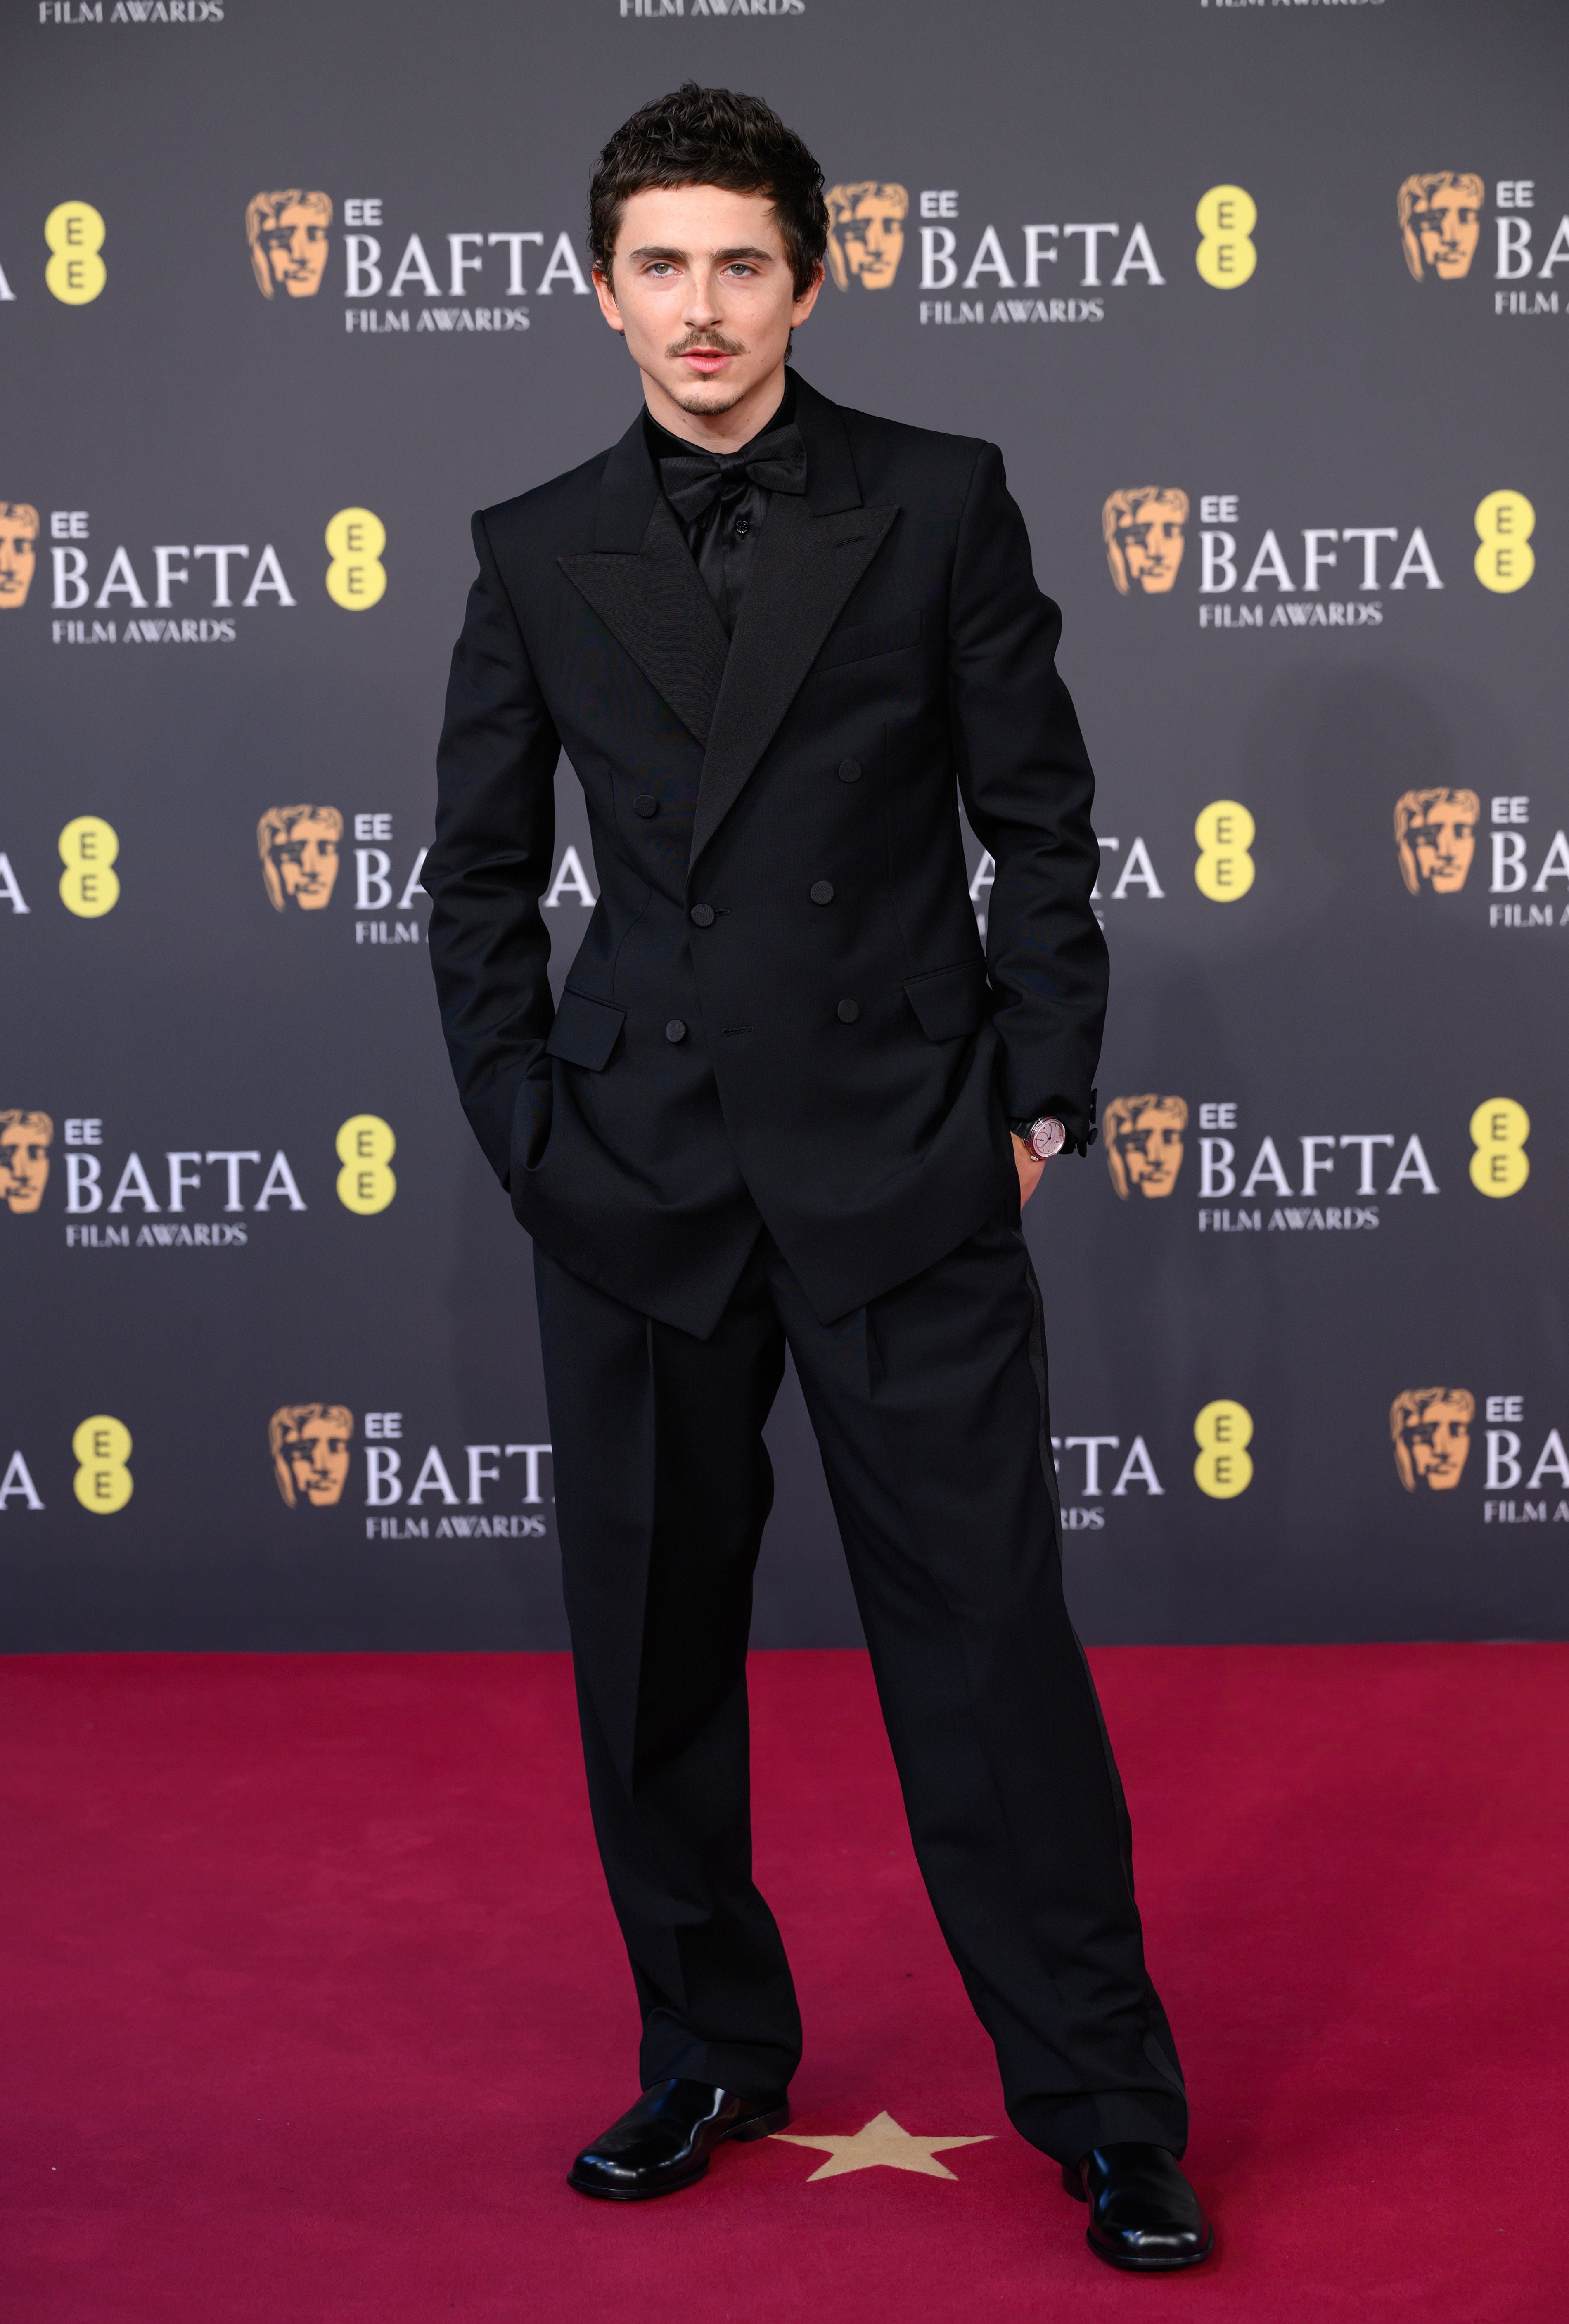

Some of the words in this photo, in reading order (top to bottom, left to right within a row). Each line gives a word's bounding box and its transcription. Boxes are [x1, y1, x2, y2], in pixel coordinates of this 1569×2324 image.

[38, 0, 103, 23] FILM
[110, 0, 225, 23] AWARDS
[920, 190, 959, 218] EE
[1496, 180, 1535, 208] EE
[344, 198, 383, 227] EE
[344, 231, 592, 298] BAFTA
[919, 222, 1166, 290] BAFTA
[920, 301, 984, 325] FILM
[991, 298, 1105, 324] AWARDS
[1495, 291, 1559, 315] FILM
[345, 309, 410, 333] FILM
[416, 307, 531, 332] AWARDS
[1200, 495, 1239, 523] EE
[50, 511, 90, 539] EE
[1199, 526, 1445, 594] BAFTA
[50, 544, 298, 609] BAFTA
[1199, 604, 1263, 628] FILM
[1270, 601, 1383, 627] AWARDS
[52, 620, 117, 644] FILM
[123, 618, 236, 643] AWARDS
[1491, 796, 1530, 824] EE
[354, 813, 393, 841] EE
[1489, 904, 1553, 928] FILM
[355, 921, 420, 944] FILM
[1199, 1102, 1238, 1130] EE
[64, 1118, 103, 1145] EE
[1198, 1134, 1441, 1198] BAFTA
[64, 1150, 308, 1214] BAFTA
[1198, 1209, 1261, 1232] FILM
[1268, 1206, 1380, 1231] AWARDS
[66, 1224, 130, 1247] FILM
[136, 1223, 248, 1247] AWARDS
[1486, 1395, 1524, 1422] EE
[365, 1412, 403, 1439] EE
[364, 1443, 555, 1506] BAFT
[1484, 1500, 1547, 1523] FILM
[366, 1517, 429, 1539] FILM
[436, 1515, 546, 1538] AWARDS
